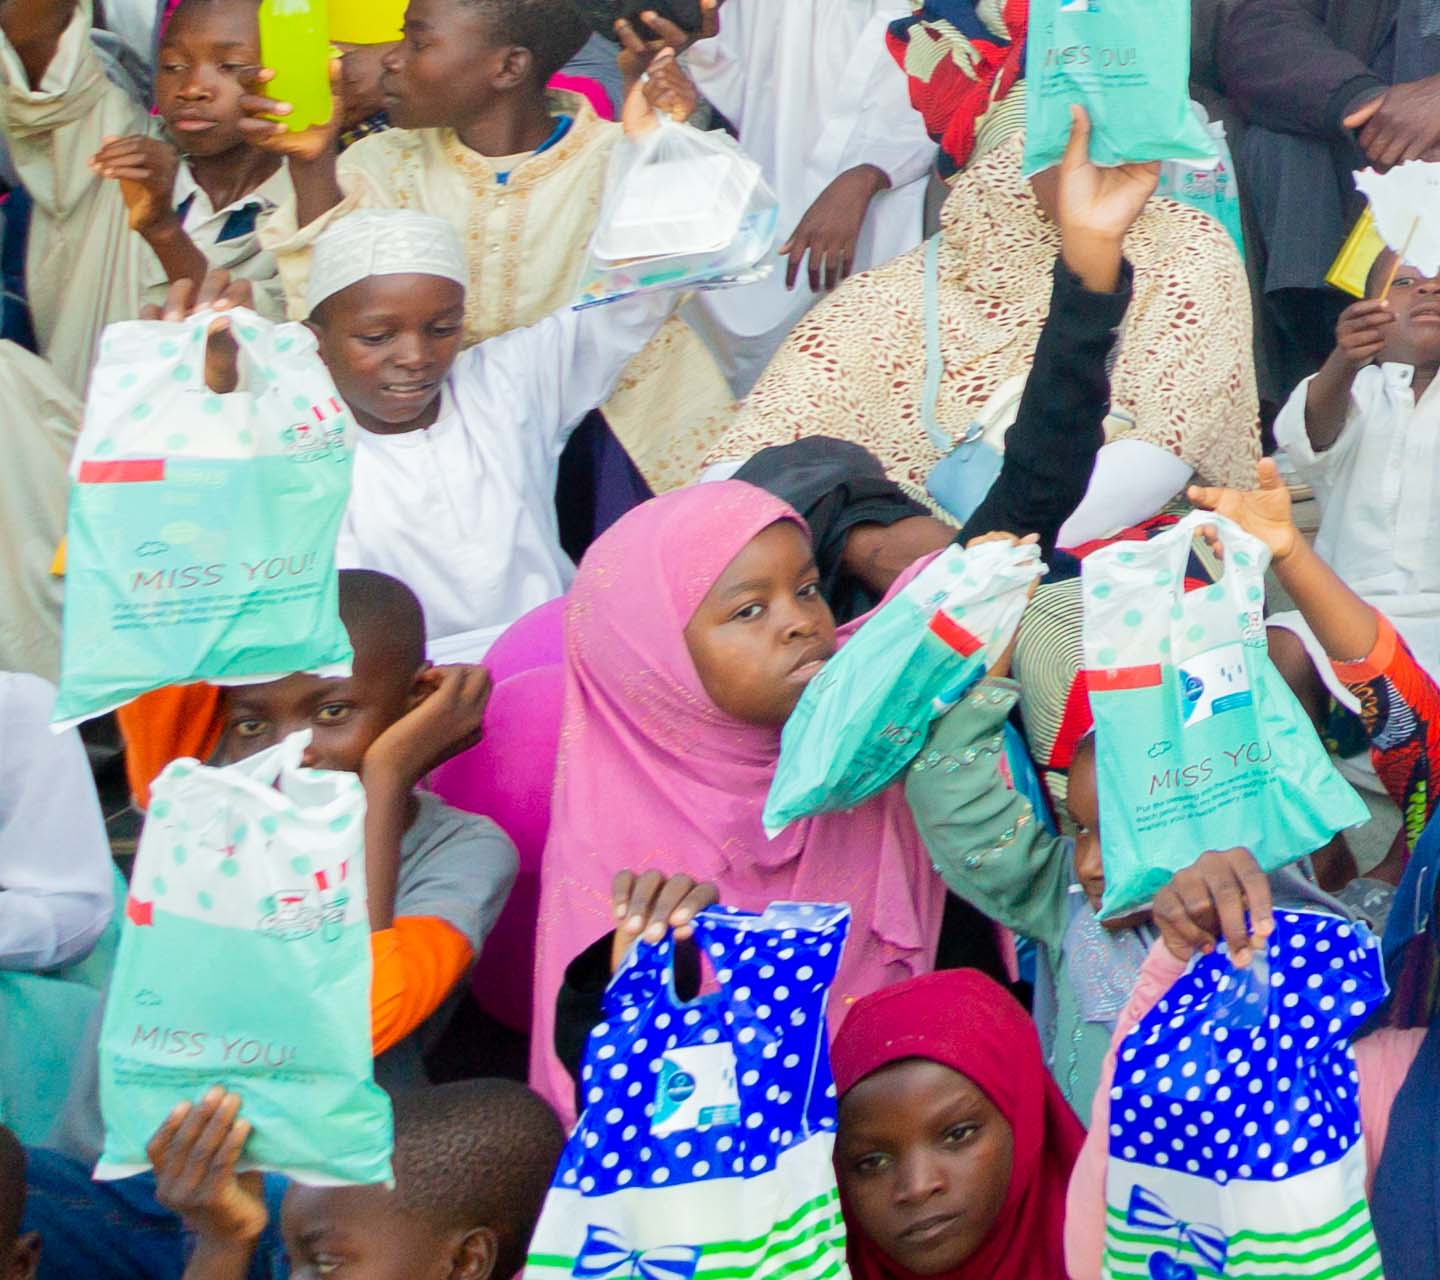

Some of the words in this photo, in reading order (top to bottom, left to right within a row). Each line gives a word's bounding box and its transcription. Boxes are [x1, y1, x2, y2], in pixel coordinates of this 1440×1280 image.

[129, 565, 222, 593] MISS
[242, 551, 316, 583] YOU!
[1149, 756, 1214, 796] MISS
[130, 1023, 210, 1058] MISS
